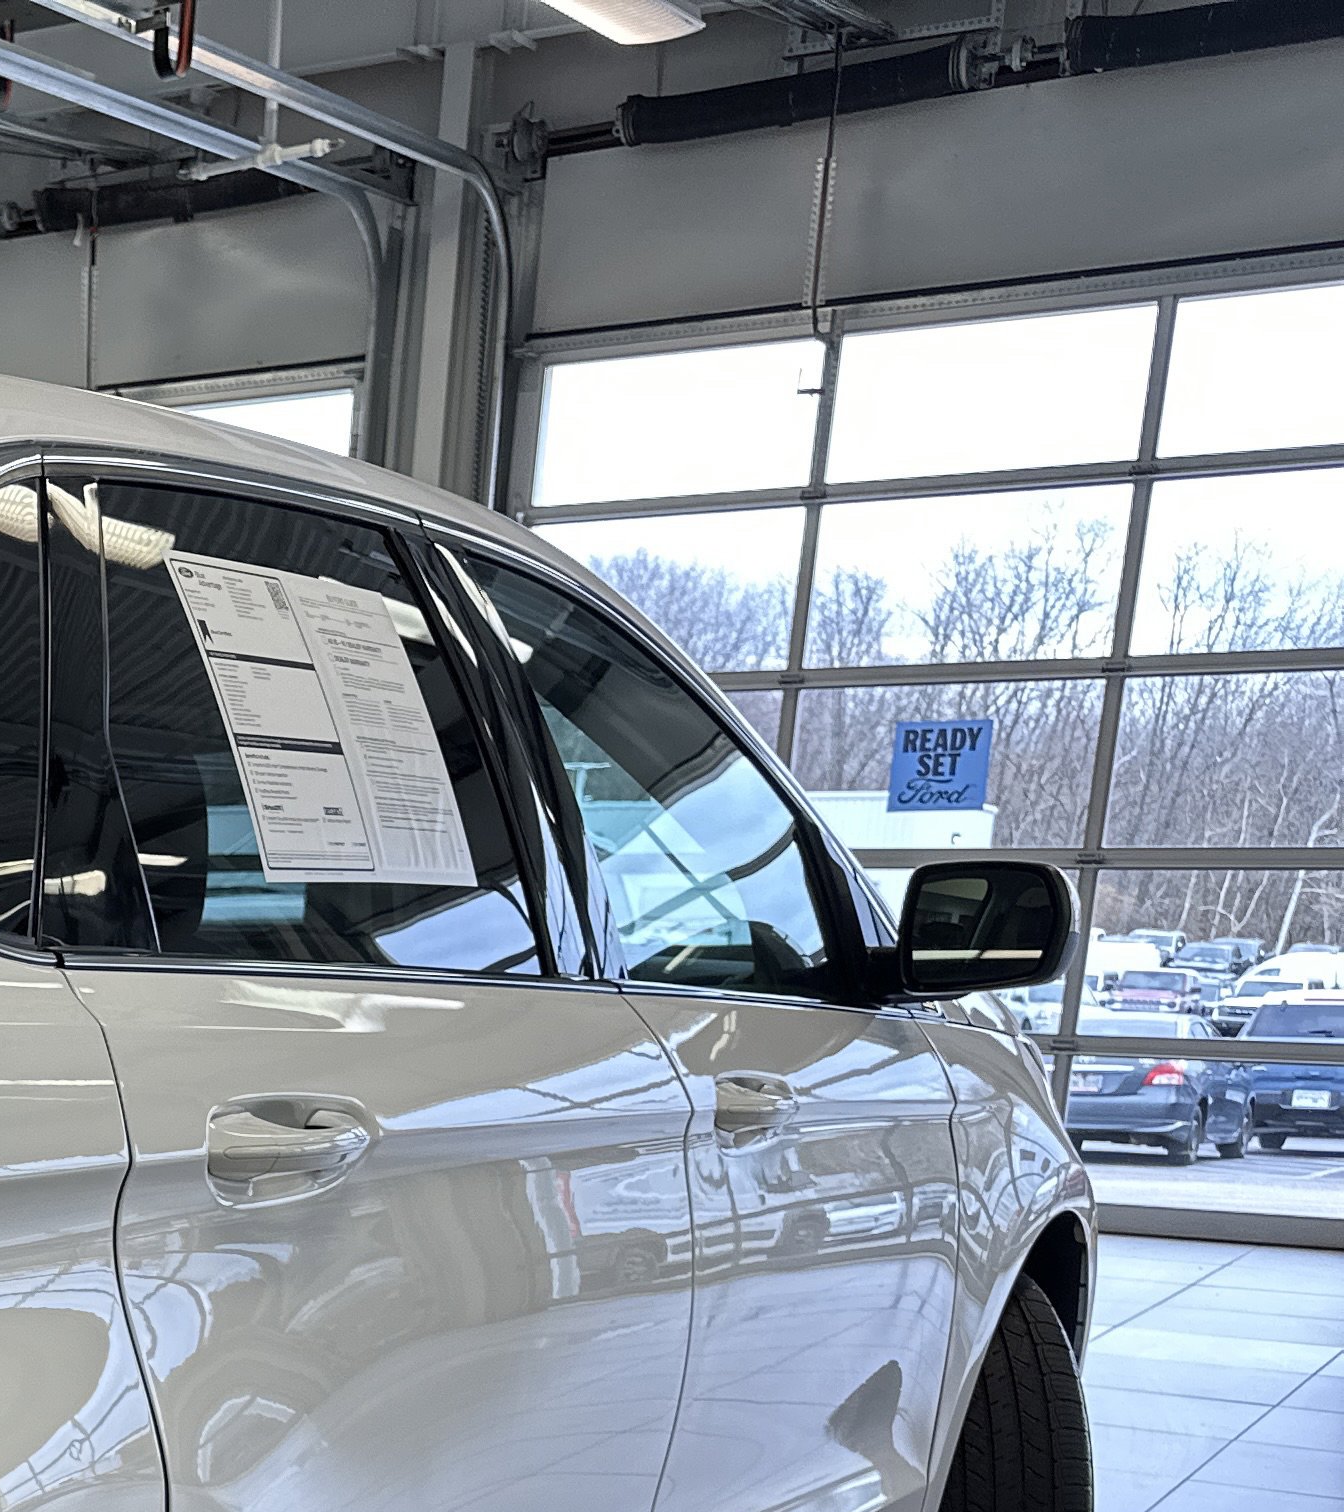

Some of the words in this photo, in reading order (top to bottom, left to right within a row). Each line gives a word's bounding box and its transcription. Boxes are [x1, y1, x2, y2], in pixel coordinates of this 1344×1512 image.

[902, 727, 983, 753] READY
[916, 753, 961, 777] SET
[897, 778, 976, 805] Ford
